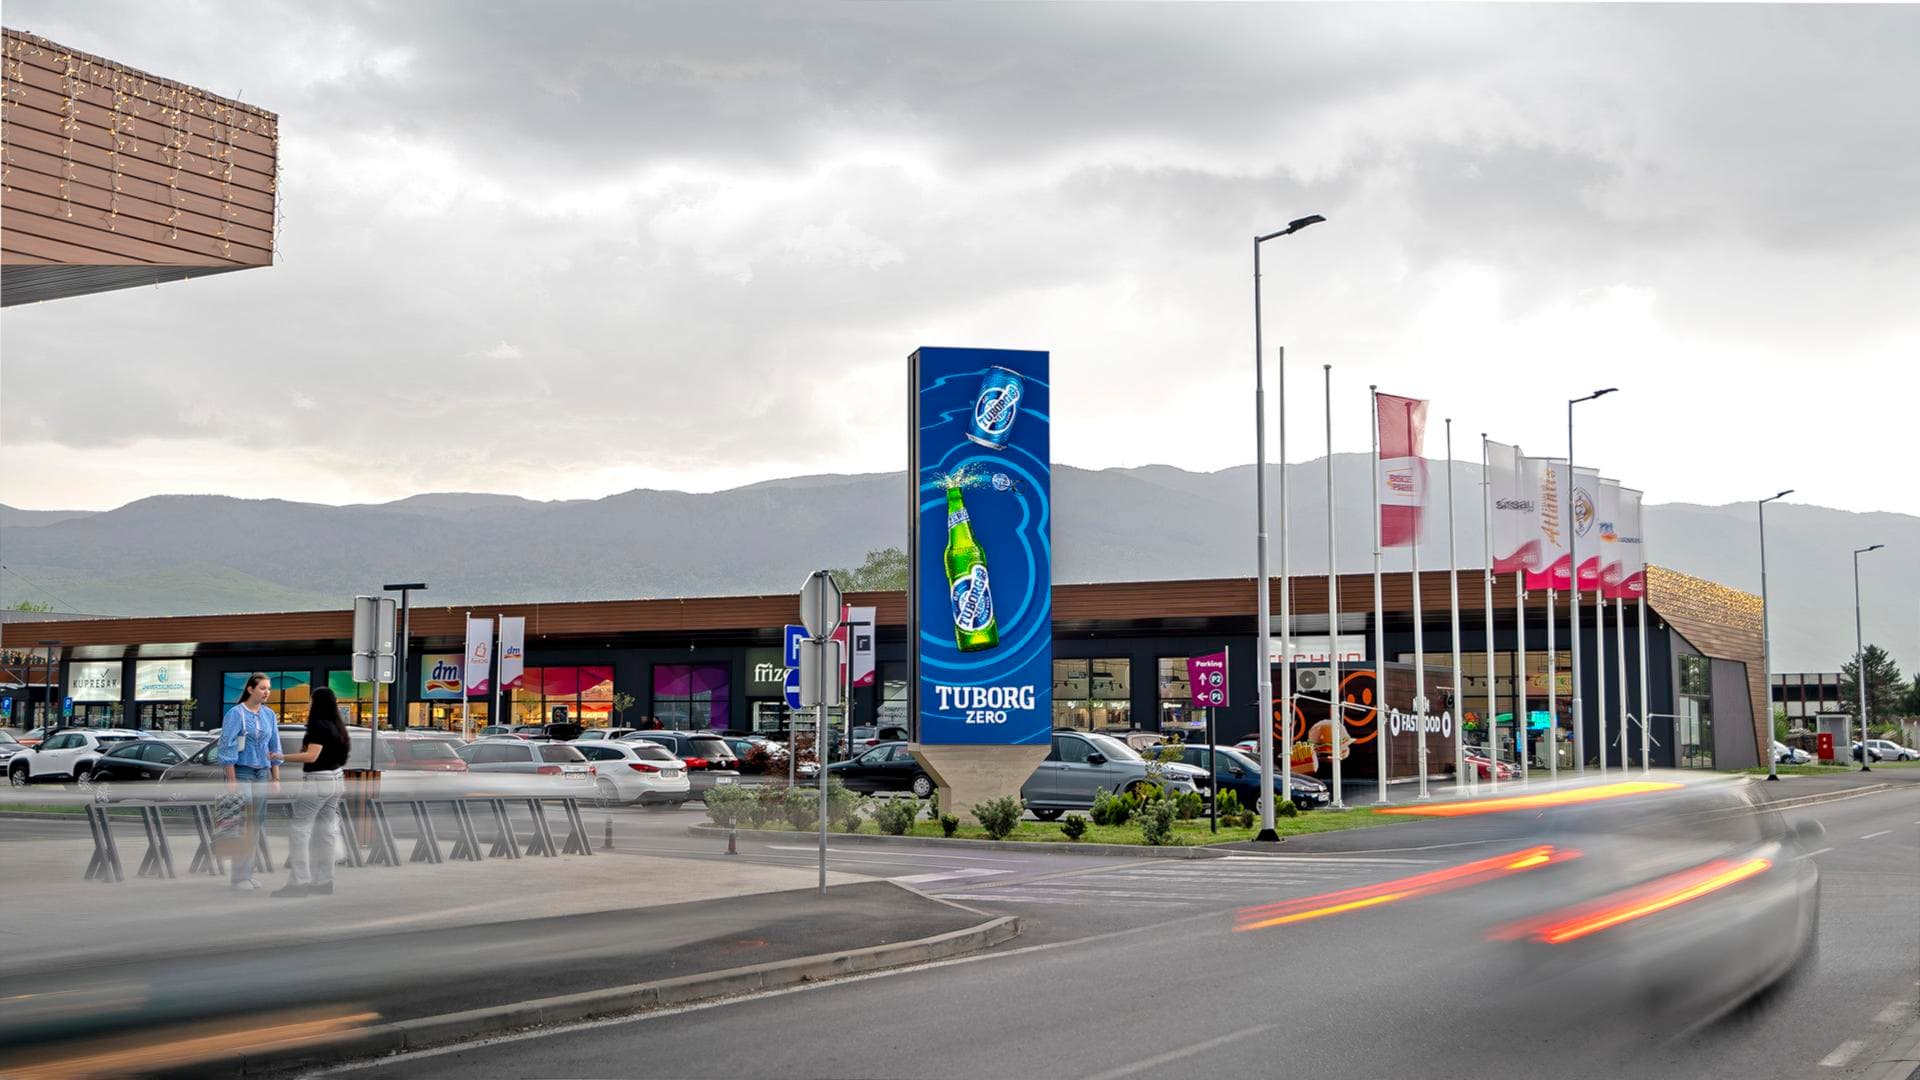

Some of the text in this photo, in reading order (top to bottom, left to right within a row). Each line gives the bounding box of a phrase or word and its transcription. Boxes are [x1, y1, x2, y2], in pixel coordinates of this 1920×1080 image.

[959, 579, 985, 627] TUBORG
[432, 660, 457, 680] dm
[1195, 659, 1223, 669] Parking
[1211, 675, 1221, 683] P2
[935, 685, 1035, 711] TUBORG
[965, 710, 1007, 724] ZERO
